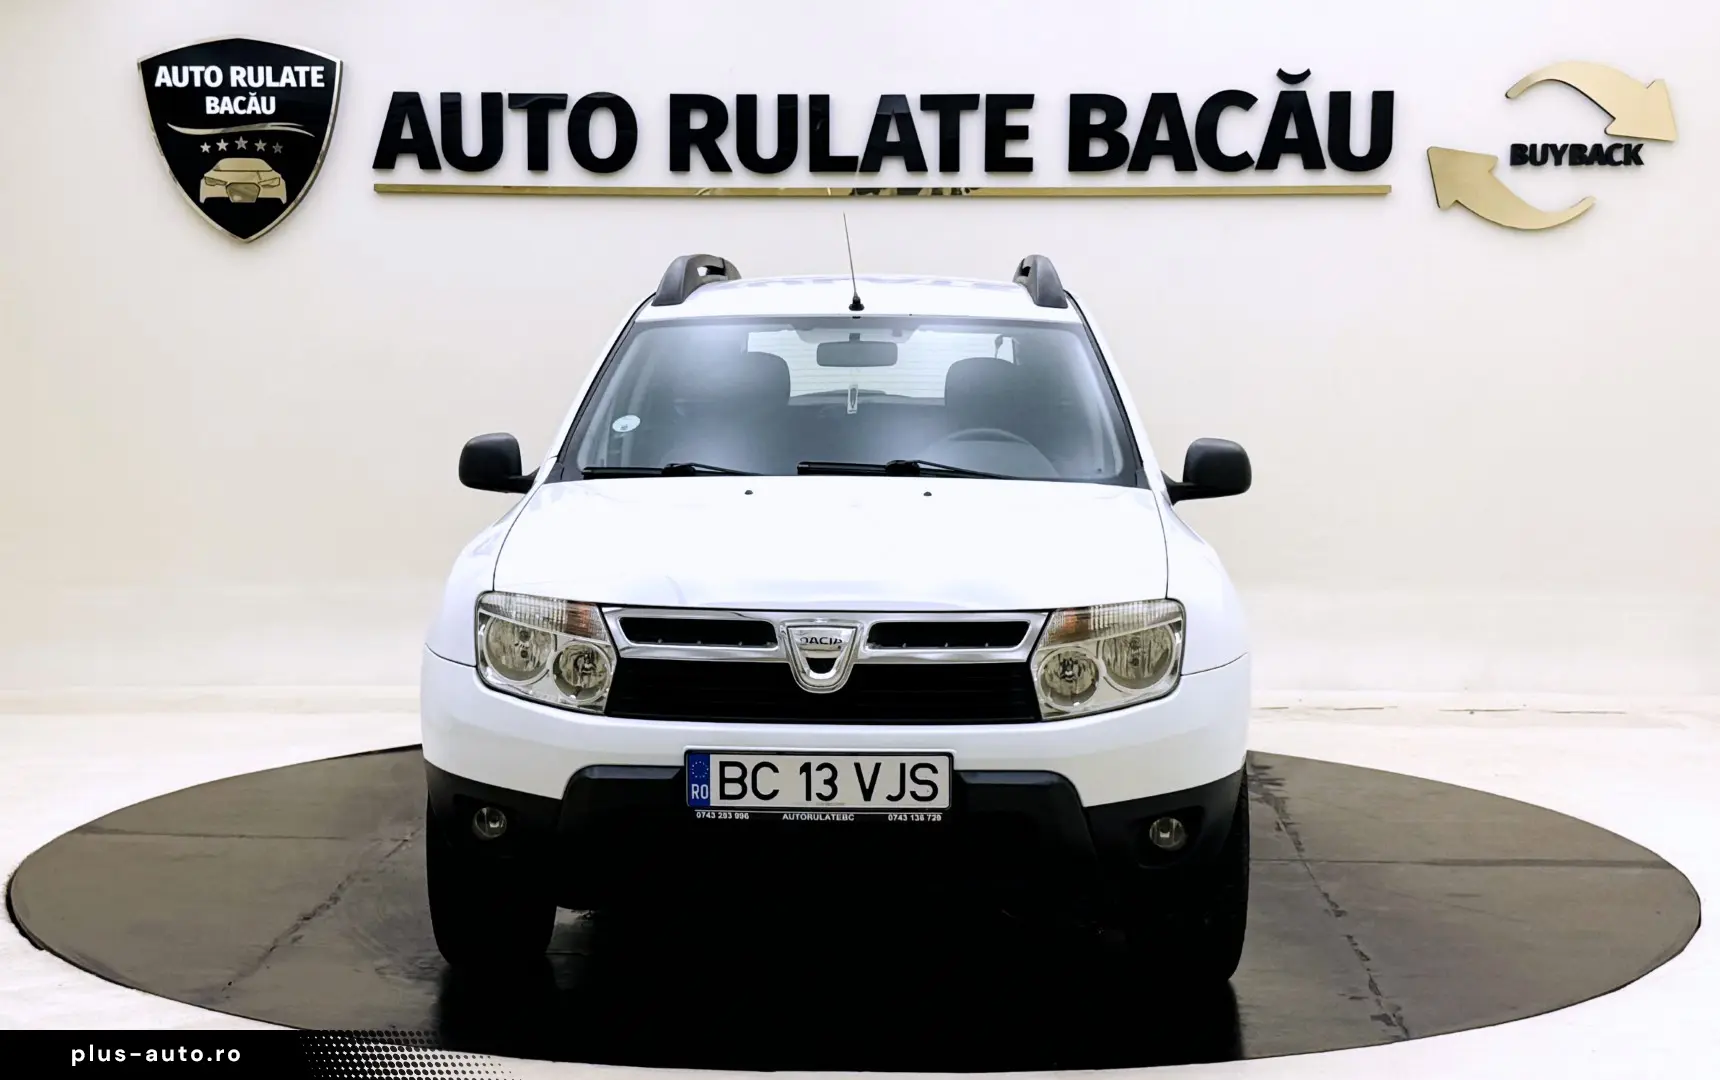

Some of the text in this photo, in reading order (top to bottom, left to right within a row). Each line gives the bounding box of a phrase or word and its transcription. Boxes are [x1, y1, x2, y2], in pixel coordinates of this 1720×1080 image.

[155, 65, 325, 88] AUTO RULATE
[205, 92, 276, 115] BACĂU
[372, 68, 1395, 174] AUTO RULATE BACĂU
[1509, 143, 1645, 168] BUYBACK
[691, 783, 709, 800] RO
[718, 760, 939, 803] BC 13 VJS
[696, 811, 716, 819] 0743
[782, 813, 855, 822] AUTORULATEBC
[887, 813, 908, 822] 0743
